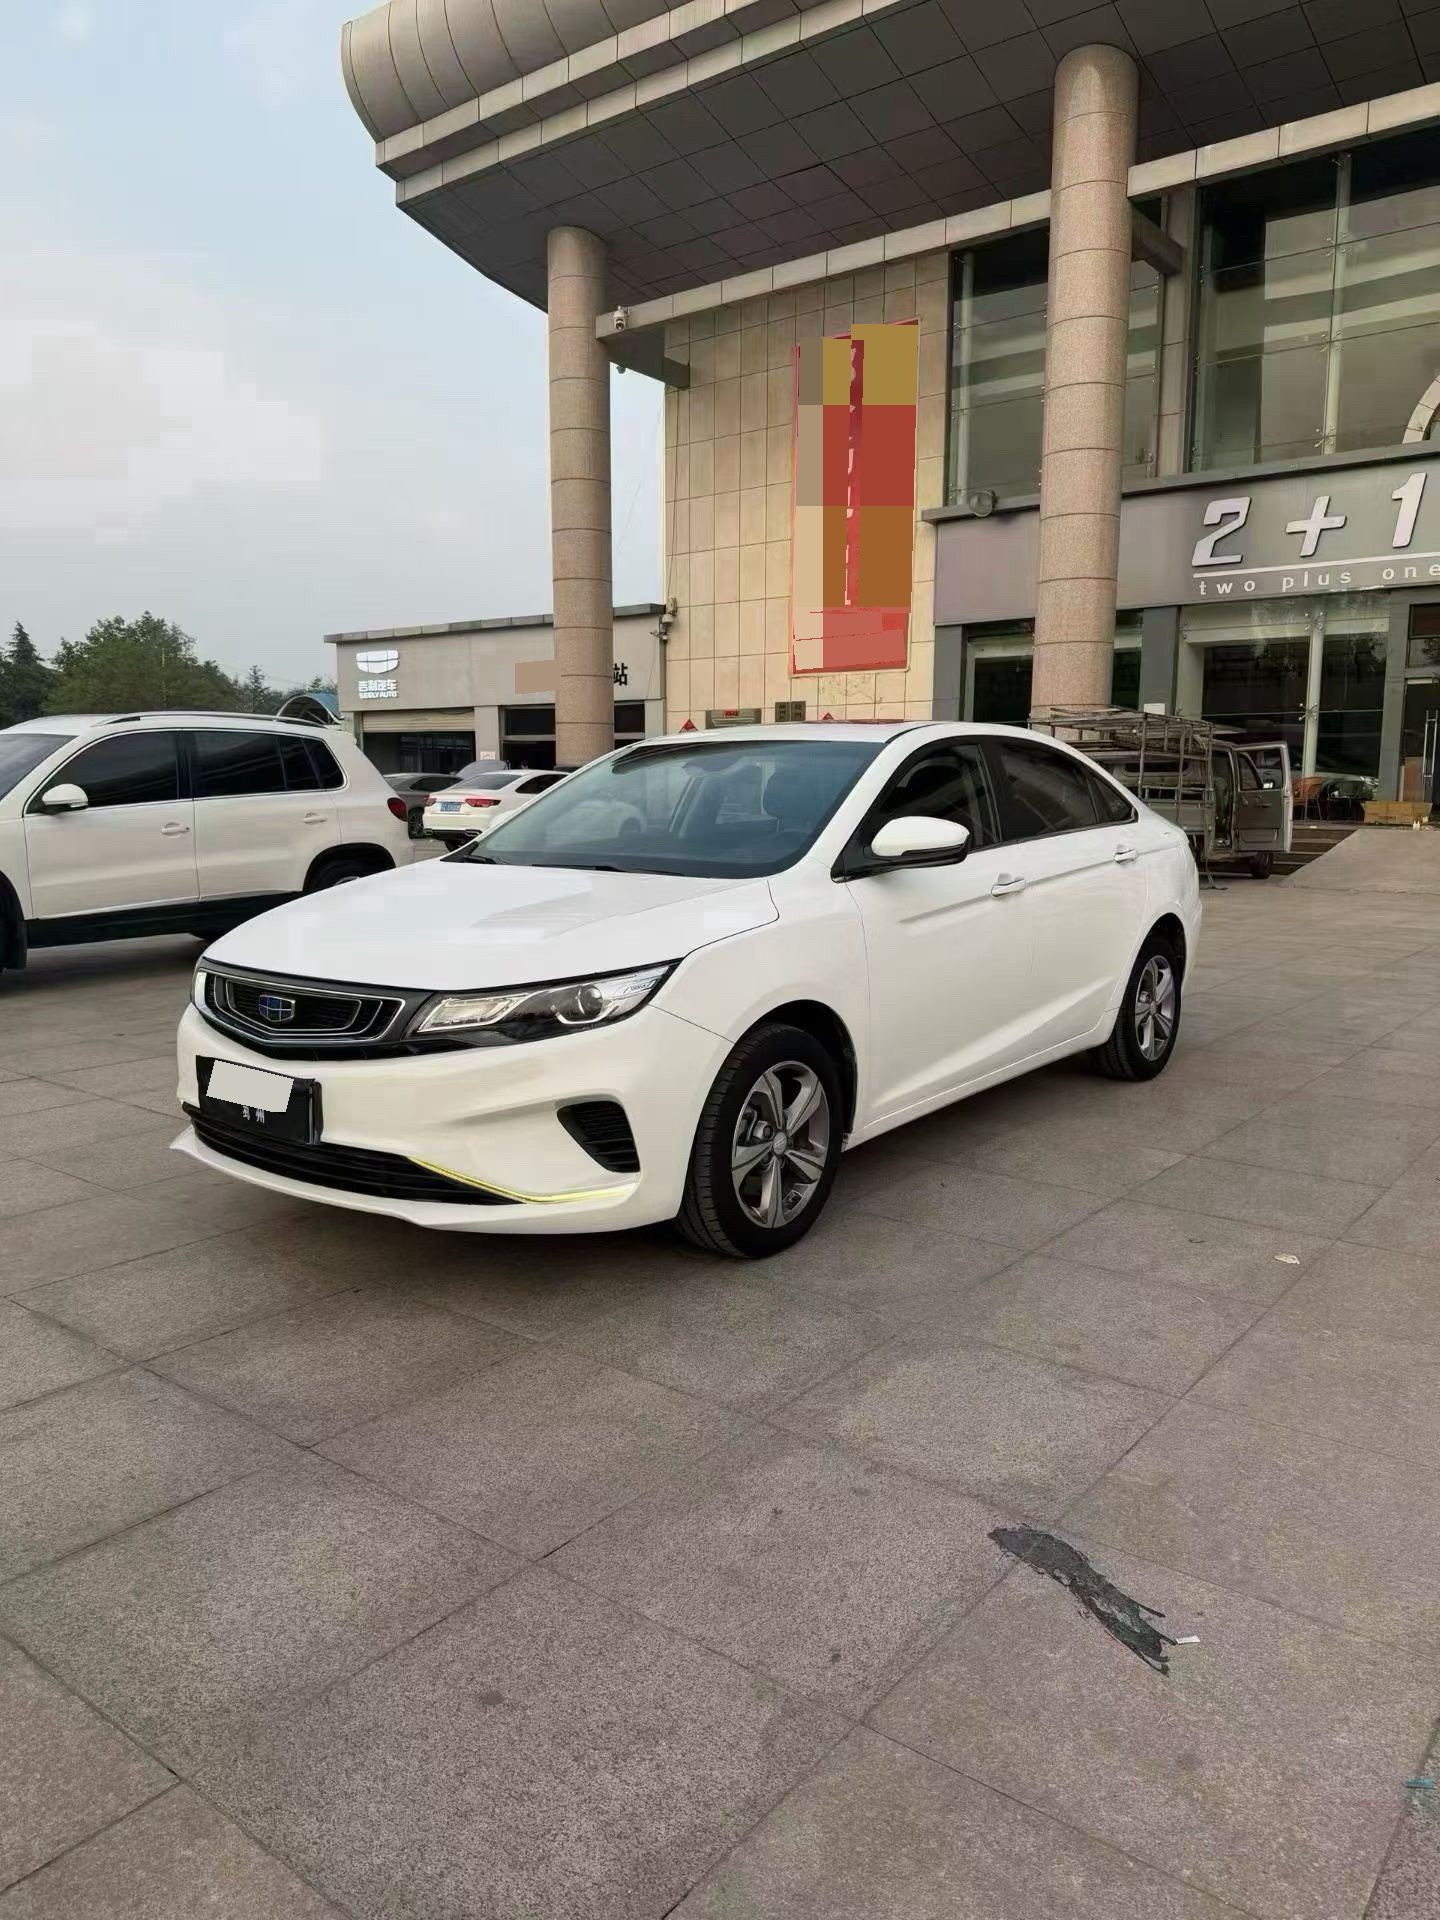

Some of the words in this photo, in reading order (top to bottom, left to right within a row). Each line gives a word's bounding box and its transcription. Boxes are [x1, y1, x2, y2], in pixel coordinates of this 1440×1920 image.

[1198, 580, 1256, 596] two
[1282, 571, 1352, 592] plus
[1382, 564, 1440, 580] one
[613, 662, 628, 686] 站
